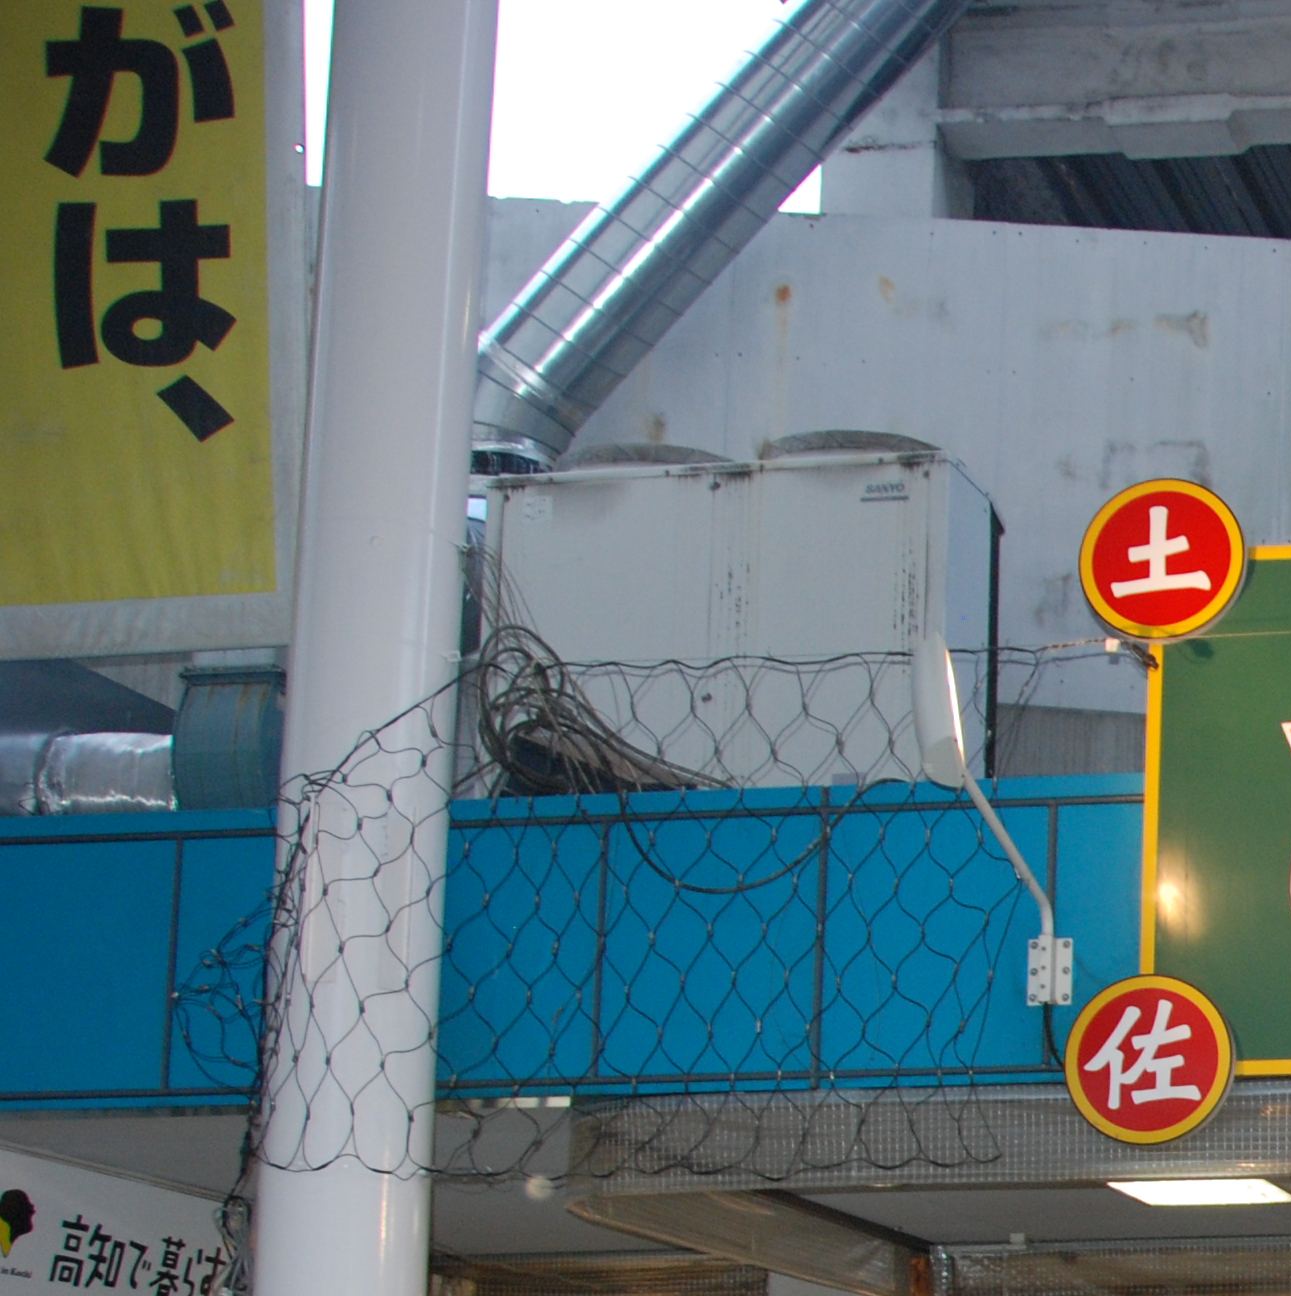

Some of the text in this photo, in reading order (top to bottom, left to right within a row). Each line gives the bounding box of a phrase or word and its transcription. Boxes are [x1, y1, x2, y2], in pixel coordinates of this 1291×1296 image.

[45, 5, 238, 443] がは、
[865, 483, 905, 494] SANYO
[1110, 505, 1212, 598] 土
[1084, 1000, 1201, 1110] 佐
